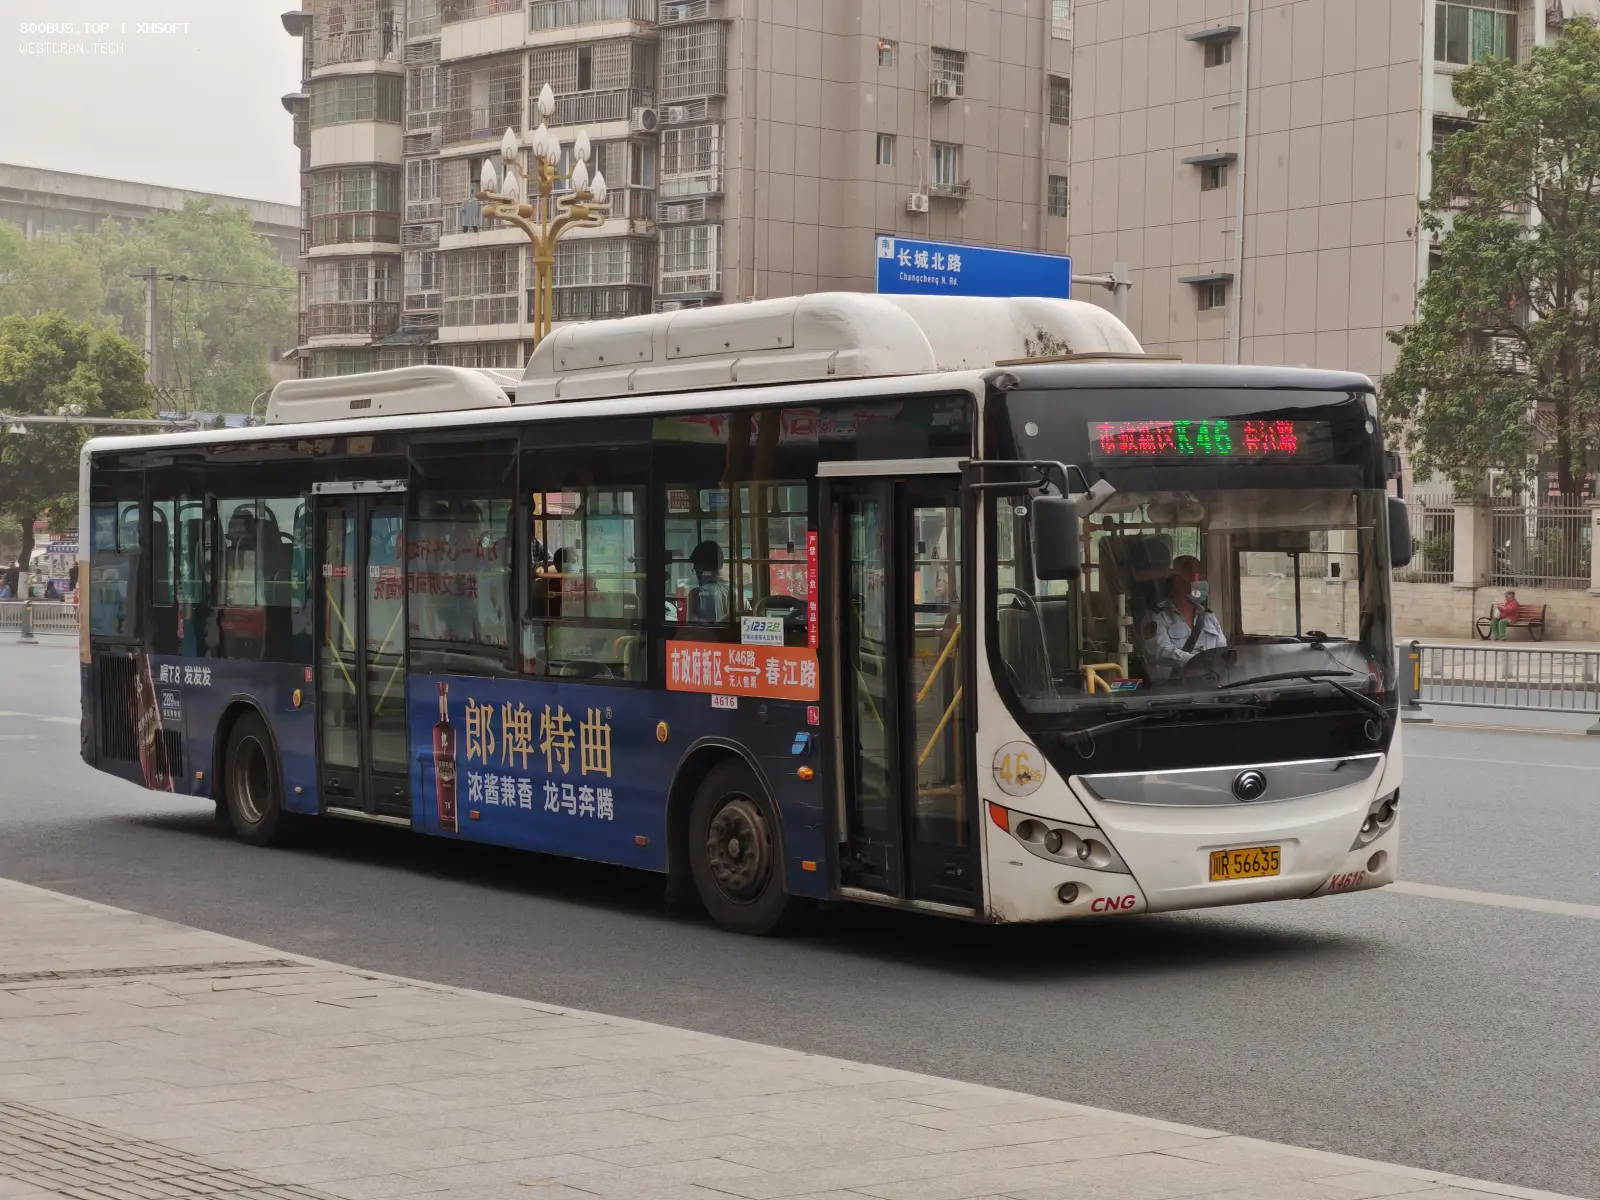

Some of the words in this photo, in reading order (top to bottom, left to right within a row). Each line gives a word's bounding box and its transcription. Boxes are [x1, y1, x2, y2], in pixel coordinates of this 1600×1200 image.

[897, 247, 962, 273] 长城北路
[900, 271, 939, 286] Changcheng
[1175, 420, 1232, 454] K46
[184, 665, 212, 687] 发发发
[671, 647, 723, 687] 市政府新区
[729, 649, 756, 668] K46路
[765, 656, 817, 689] 春江路
[729, 674, 757, 689] 无人售票
[713, 696, 735, 707] 4616
[465, 697, 612, 778] 郎牌特曲
[467, 771, 533, 810] 浓酱兼香
[543, 780, 614, 821] 龙马奔腾
[1328, 870, 1366, 890] K4616
[1090, 894, 1136, 913] CNG
